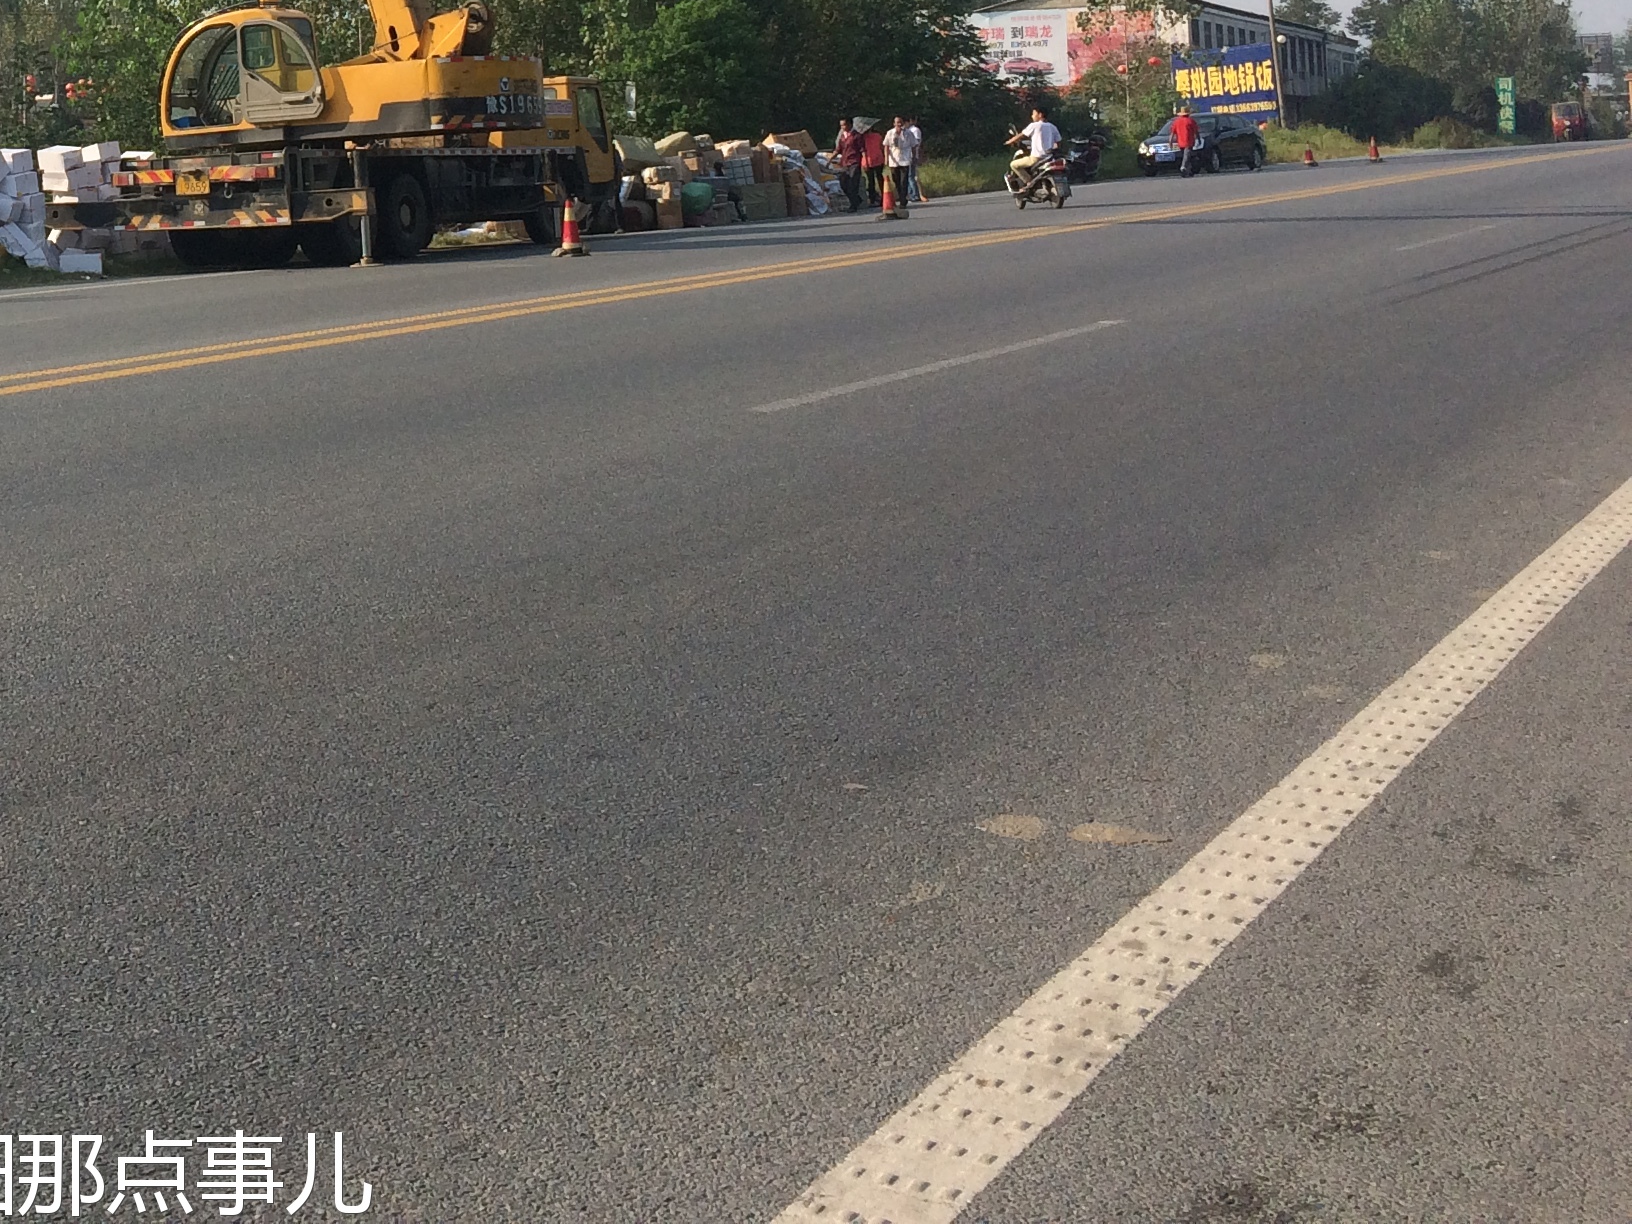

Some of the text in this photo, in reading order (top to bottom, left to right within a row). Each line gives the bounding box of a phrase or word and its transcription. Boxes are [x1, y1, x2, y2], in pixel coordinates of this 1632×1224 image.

[1175, 59, 1274, 99] 樱桃园地锅饭
